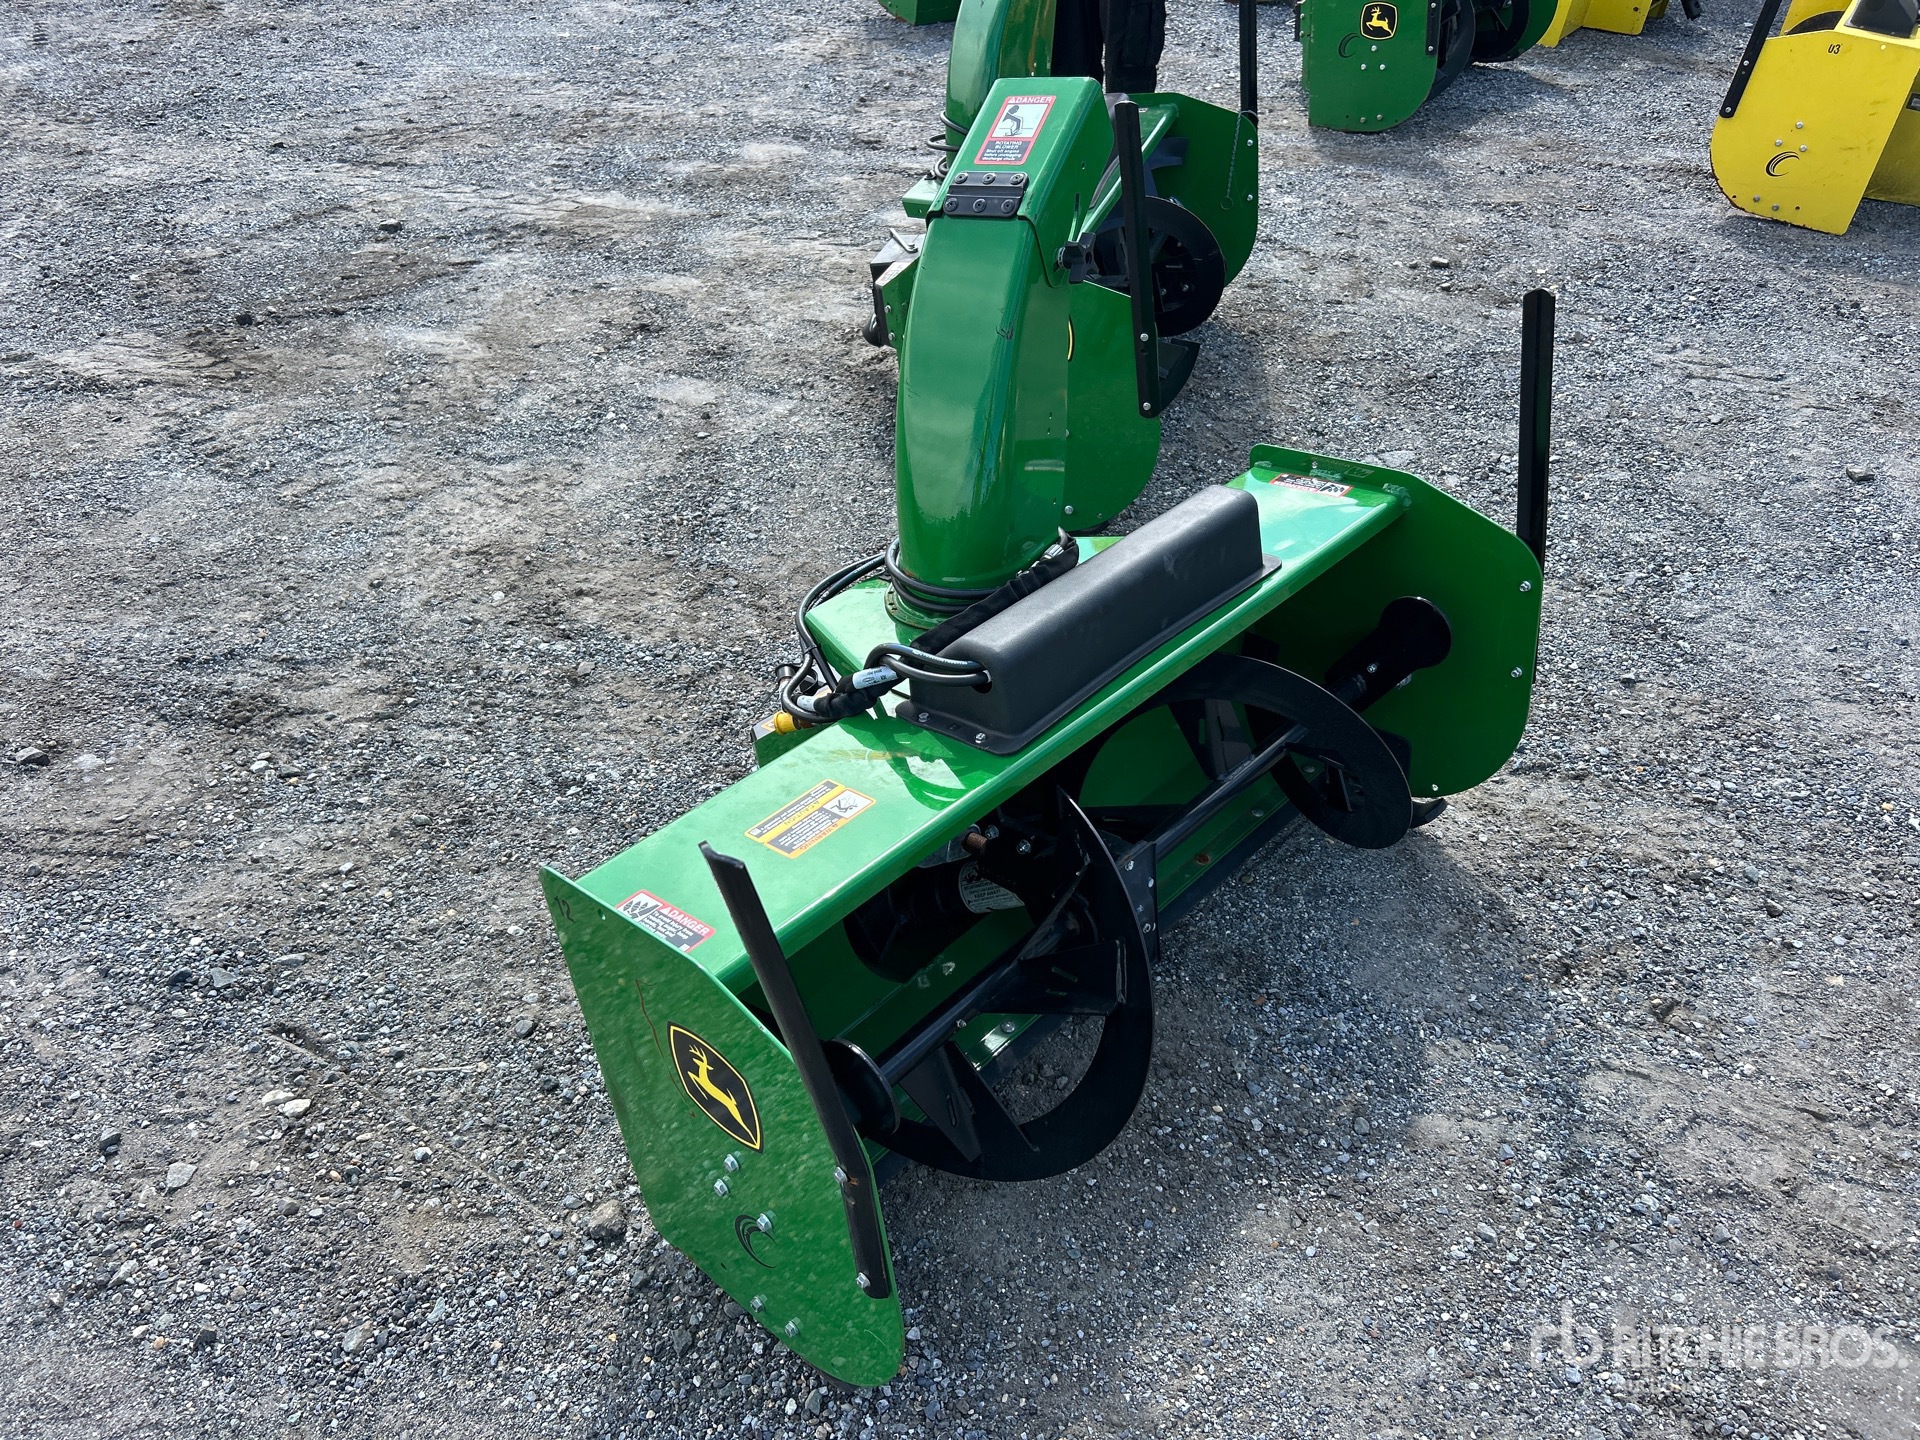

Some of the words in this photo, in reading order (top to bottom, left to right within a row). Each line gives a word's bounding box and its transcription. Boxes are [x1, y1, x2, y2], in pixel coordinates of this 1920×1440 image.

[784, 804, 815, 825] CAUTION
[800, 825, 835, 850] WARNING
[668, 910, 710, 936] DANGER
